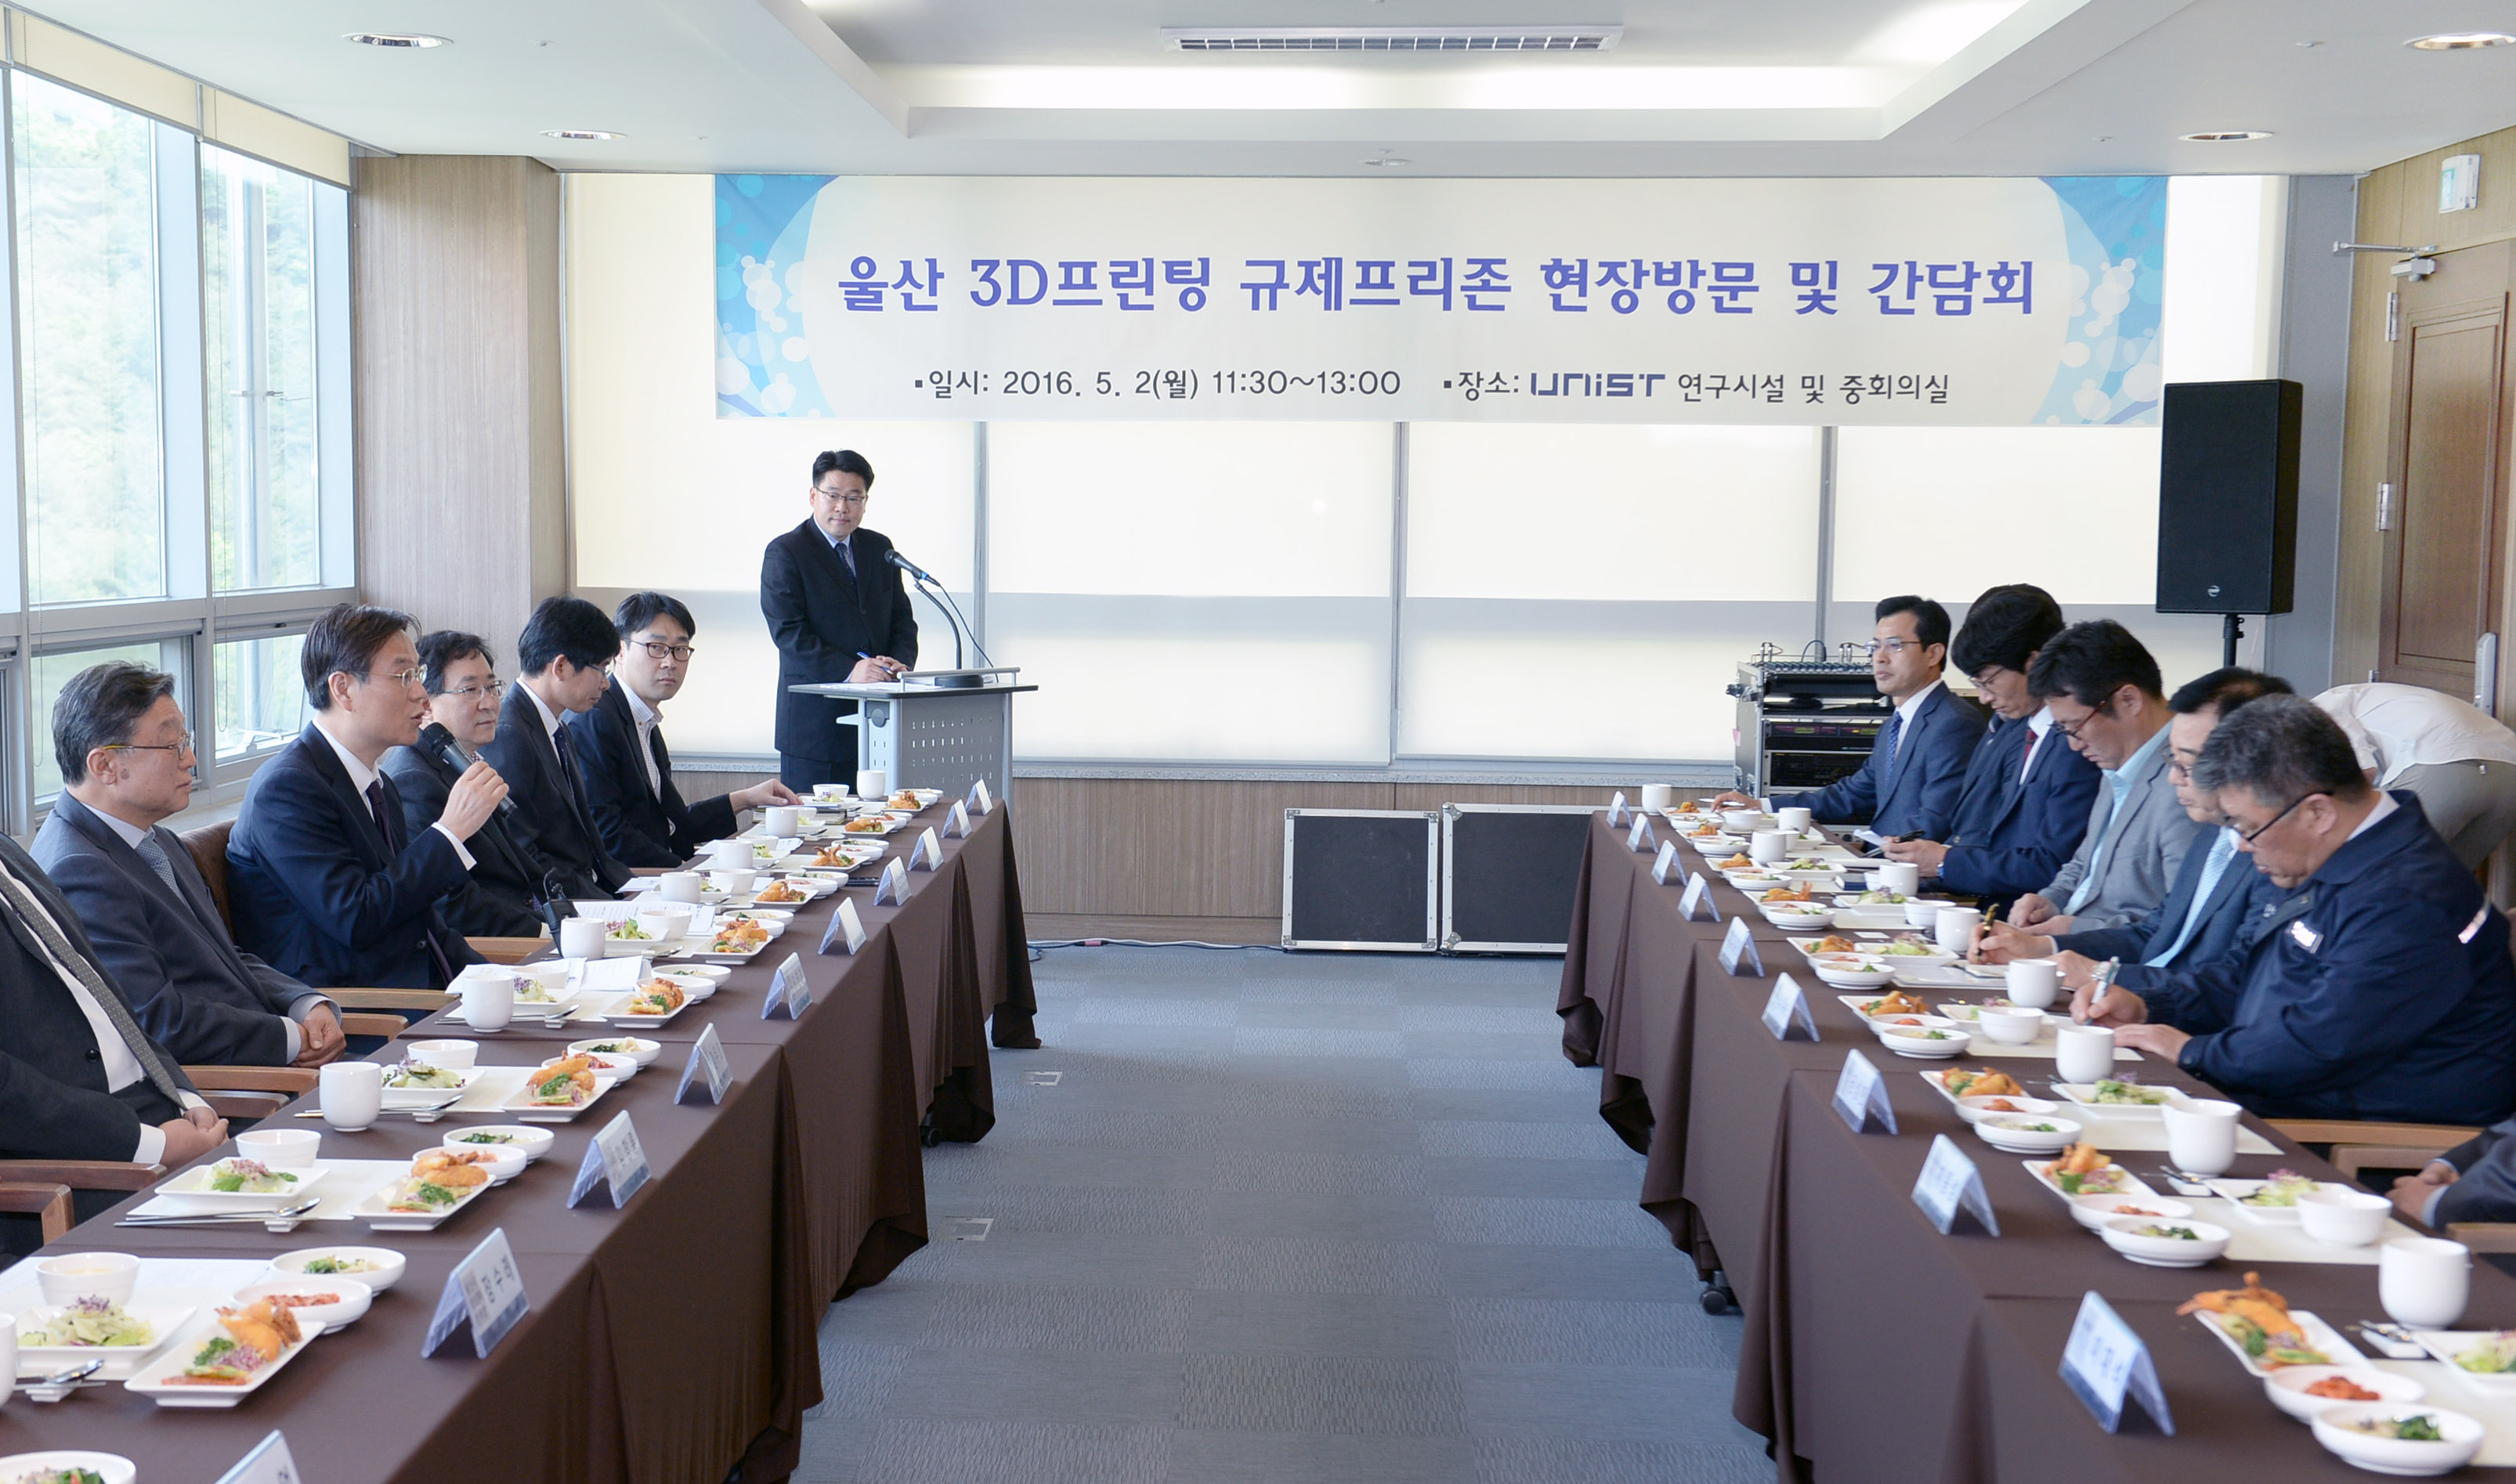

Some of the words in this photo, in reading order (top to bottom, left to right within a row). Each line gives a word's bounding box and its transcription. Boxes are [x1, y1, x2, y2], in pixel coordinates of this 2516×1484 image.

[838, 255, 945, 312] 울산
[970, 257, 1211, 312] 3D프린팅
[1240, 257, 1513, 312] 규제프리존
[1540, 258, 1760, 316] 현장방문
[1788, 260, 1839, 316] 및
[1867, 259, 2034, 317] 간담회
[929, 370, 989, 399] 일시:
[1003, 370, 1081, 397] 2016.
[1096, 371, 1120, 397] 5.
[1135, 370, 1199, 400] 2(월)
[1213, 370, 1401, 395] 11:30~13:00
[1458, 370, 1520, 402] 장소:
[1678, 373, 1784, 403] 연구시설
[1801, 374, 1825, 405] 및
[1838, 374, 1950, 405] 중회의실
